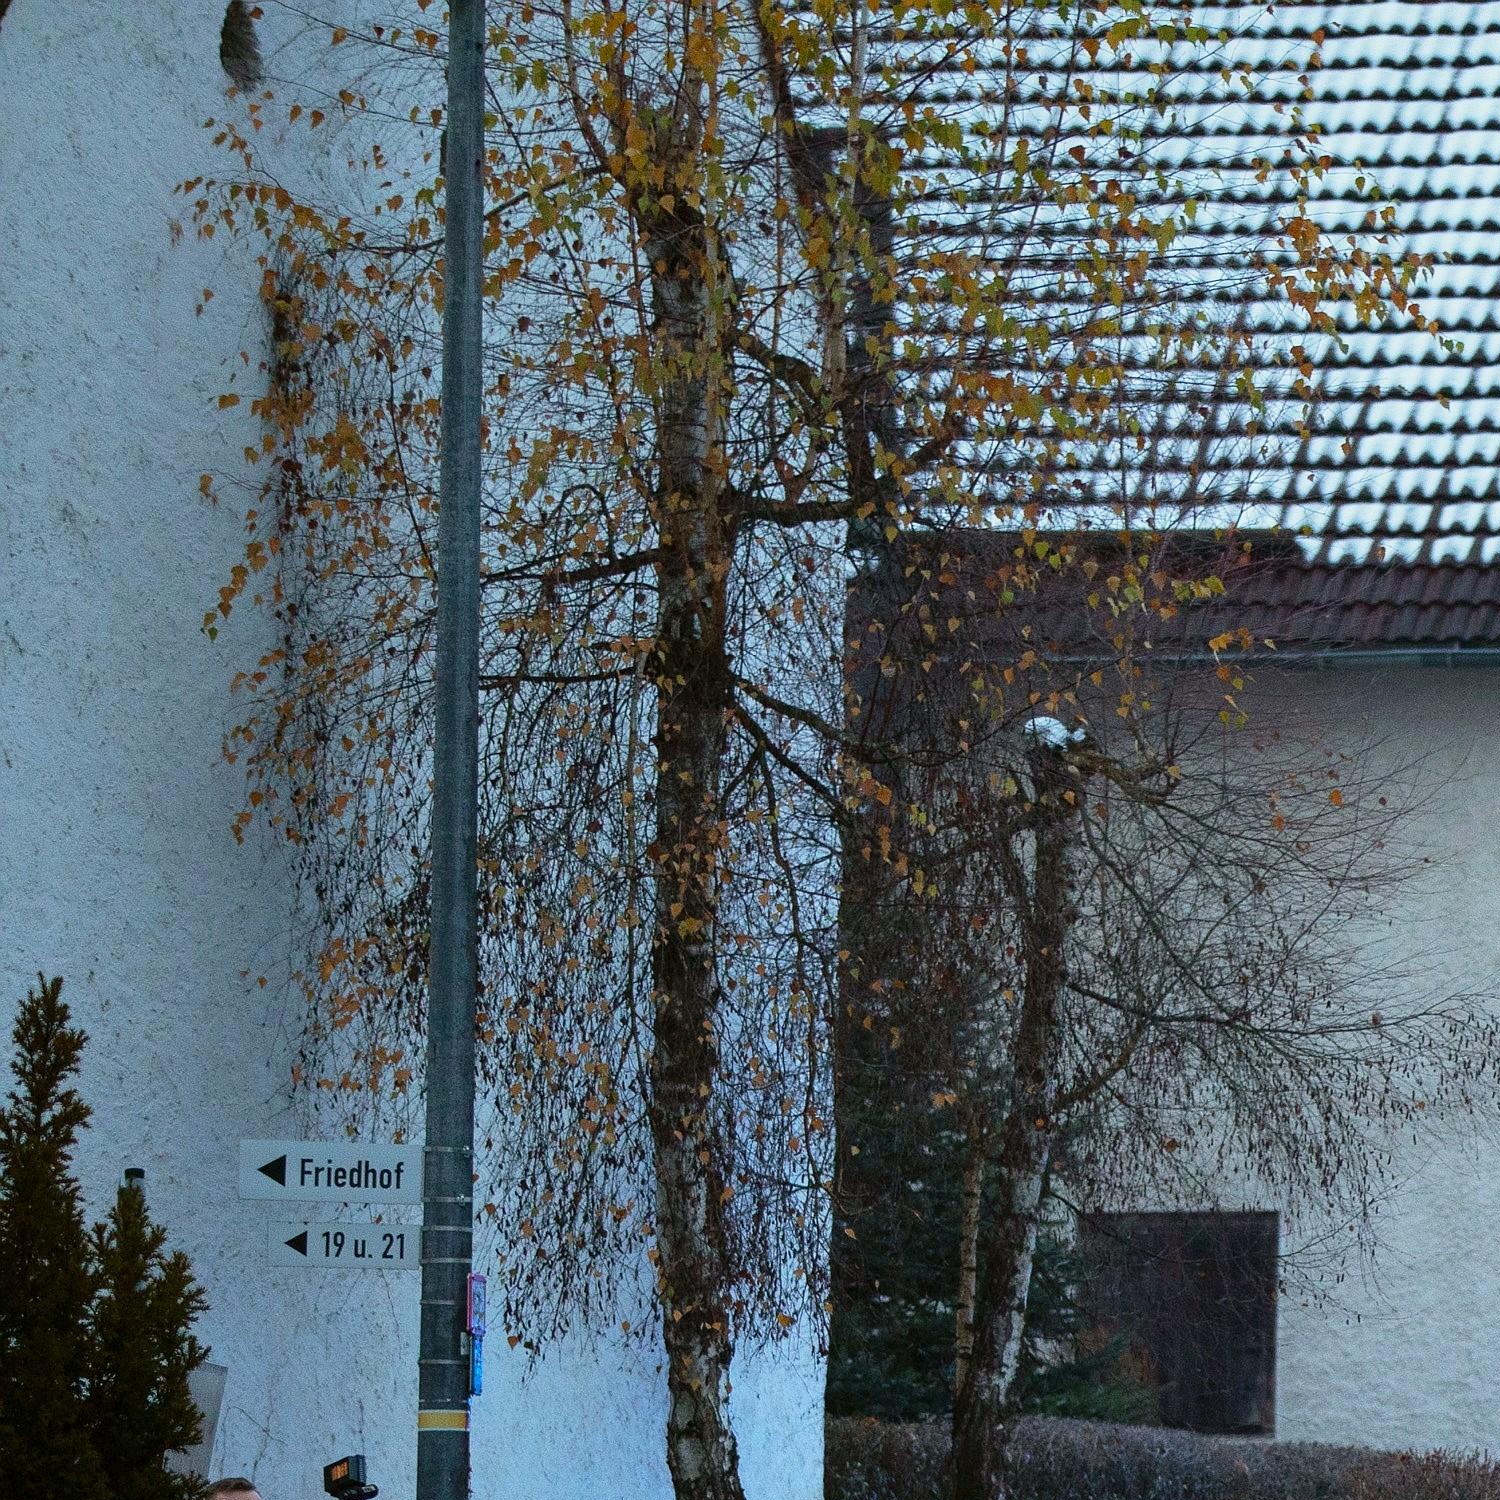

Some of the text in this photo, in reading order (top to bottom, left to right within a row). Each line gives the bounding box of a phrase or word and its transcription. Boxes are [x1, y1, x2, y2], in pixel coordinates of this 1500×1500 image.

[300, 1158, 404, 1189] Friedhof
[322, 1231, 405, 1260] 19 u. 21
